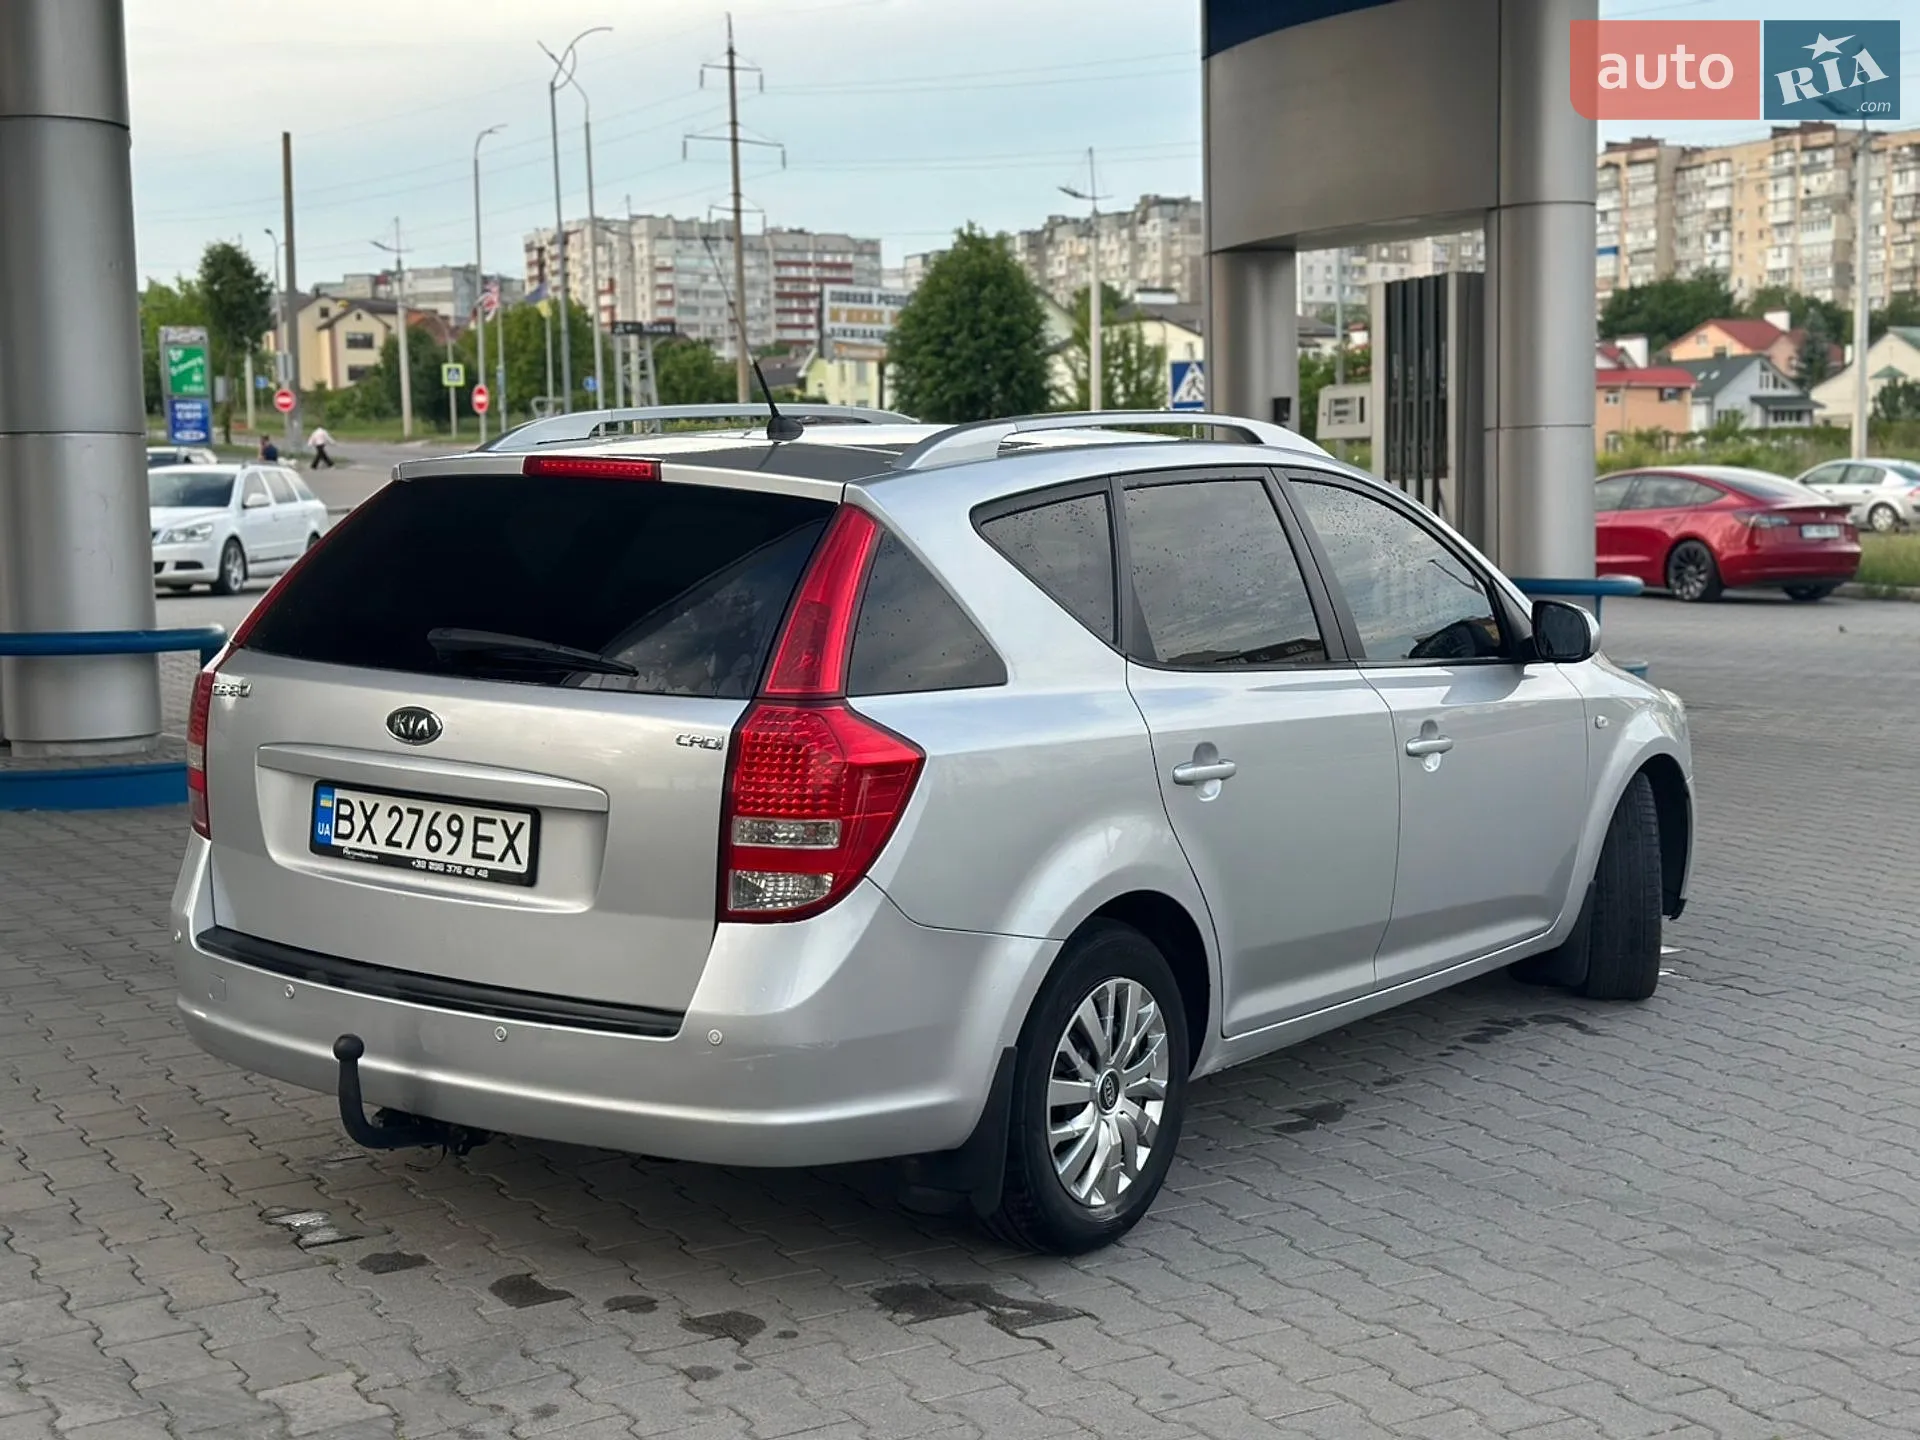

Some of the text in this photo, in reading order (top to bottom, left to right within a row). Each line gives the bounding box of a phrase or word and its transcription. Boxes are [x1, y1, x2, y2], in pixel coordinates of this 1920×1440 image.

[393, 713, 430, 737] KIA
[317, 822, 331, 836] UA
[333, 797, 525, 866] BX 2769 EX
